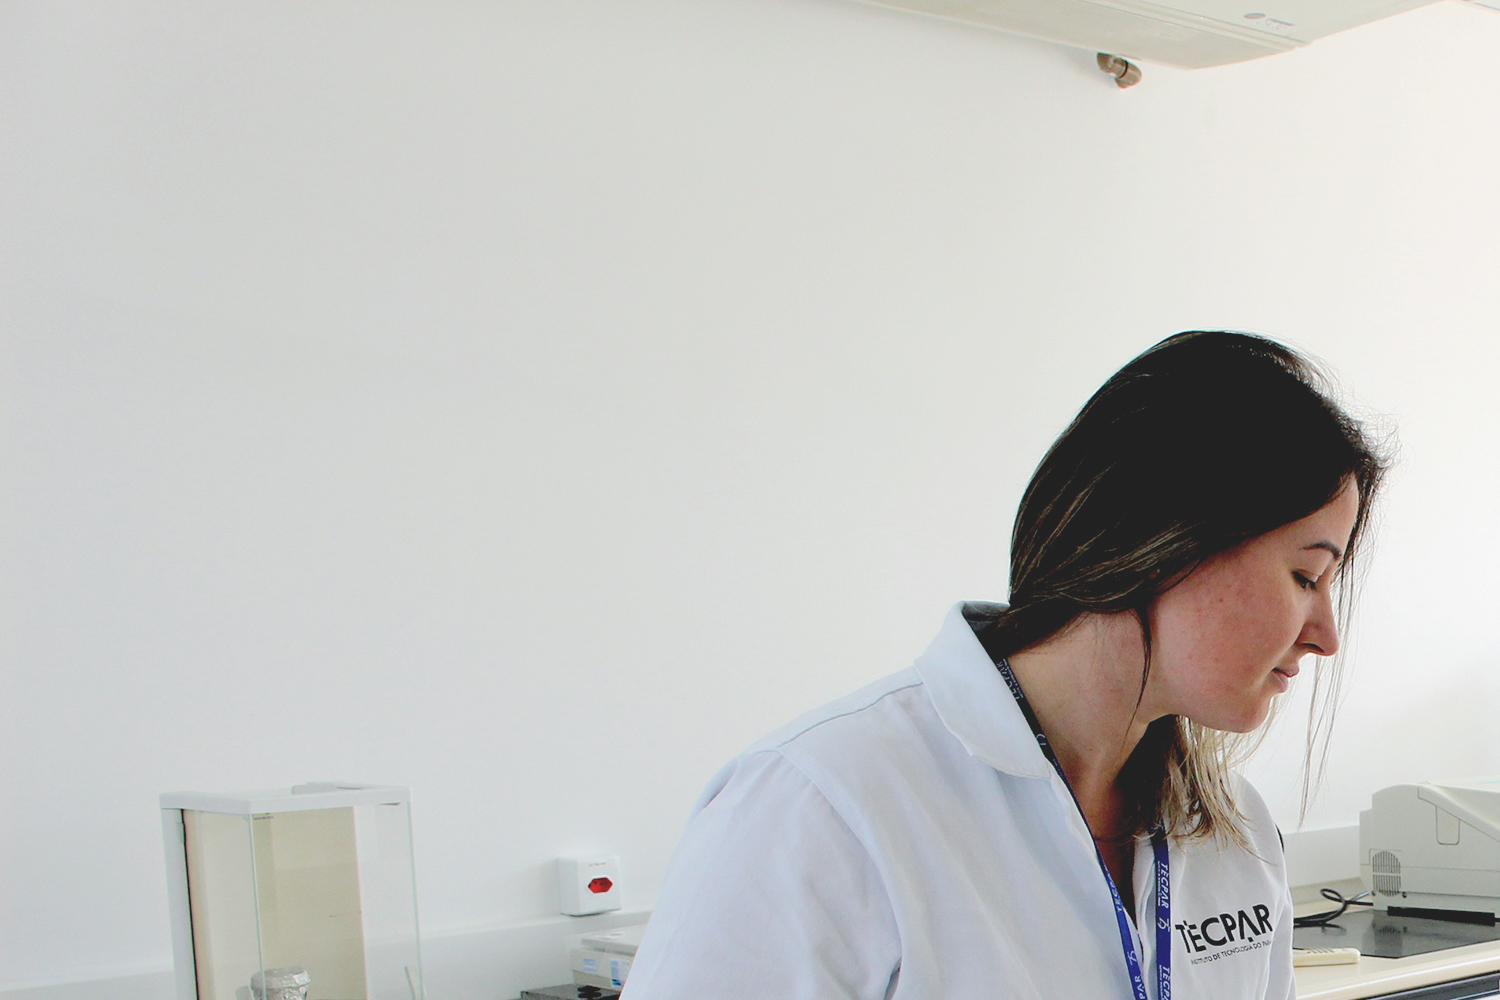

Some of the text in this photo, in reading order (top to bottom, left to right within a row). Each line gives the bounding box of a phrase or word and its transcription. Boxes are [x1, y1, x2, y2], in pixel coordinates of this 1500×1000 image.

[1160, 862, 1169, 909] TECPAR
[1174, 904, 1274, 954] TECPAR
[1212, 953, 1221, 961] DE
[1221, 943, 1253, 957] TECNOLOGIA
